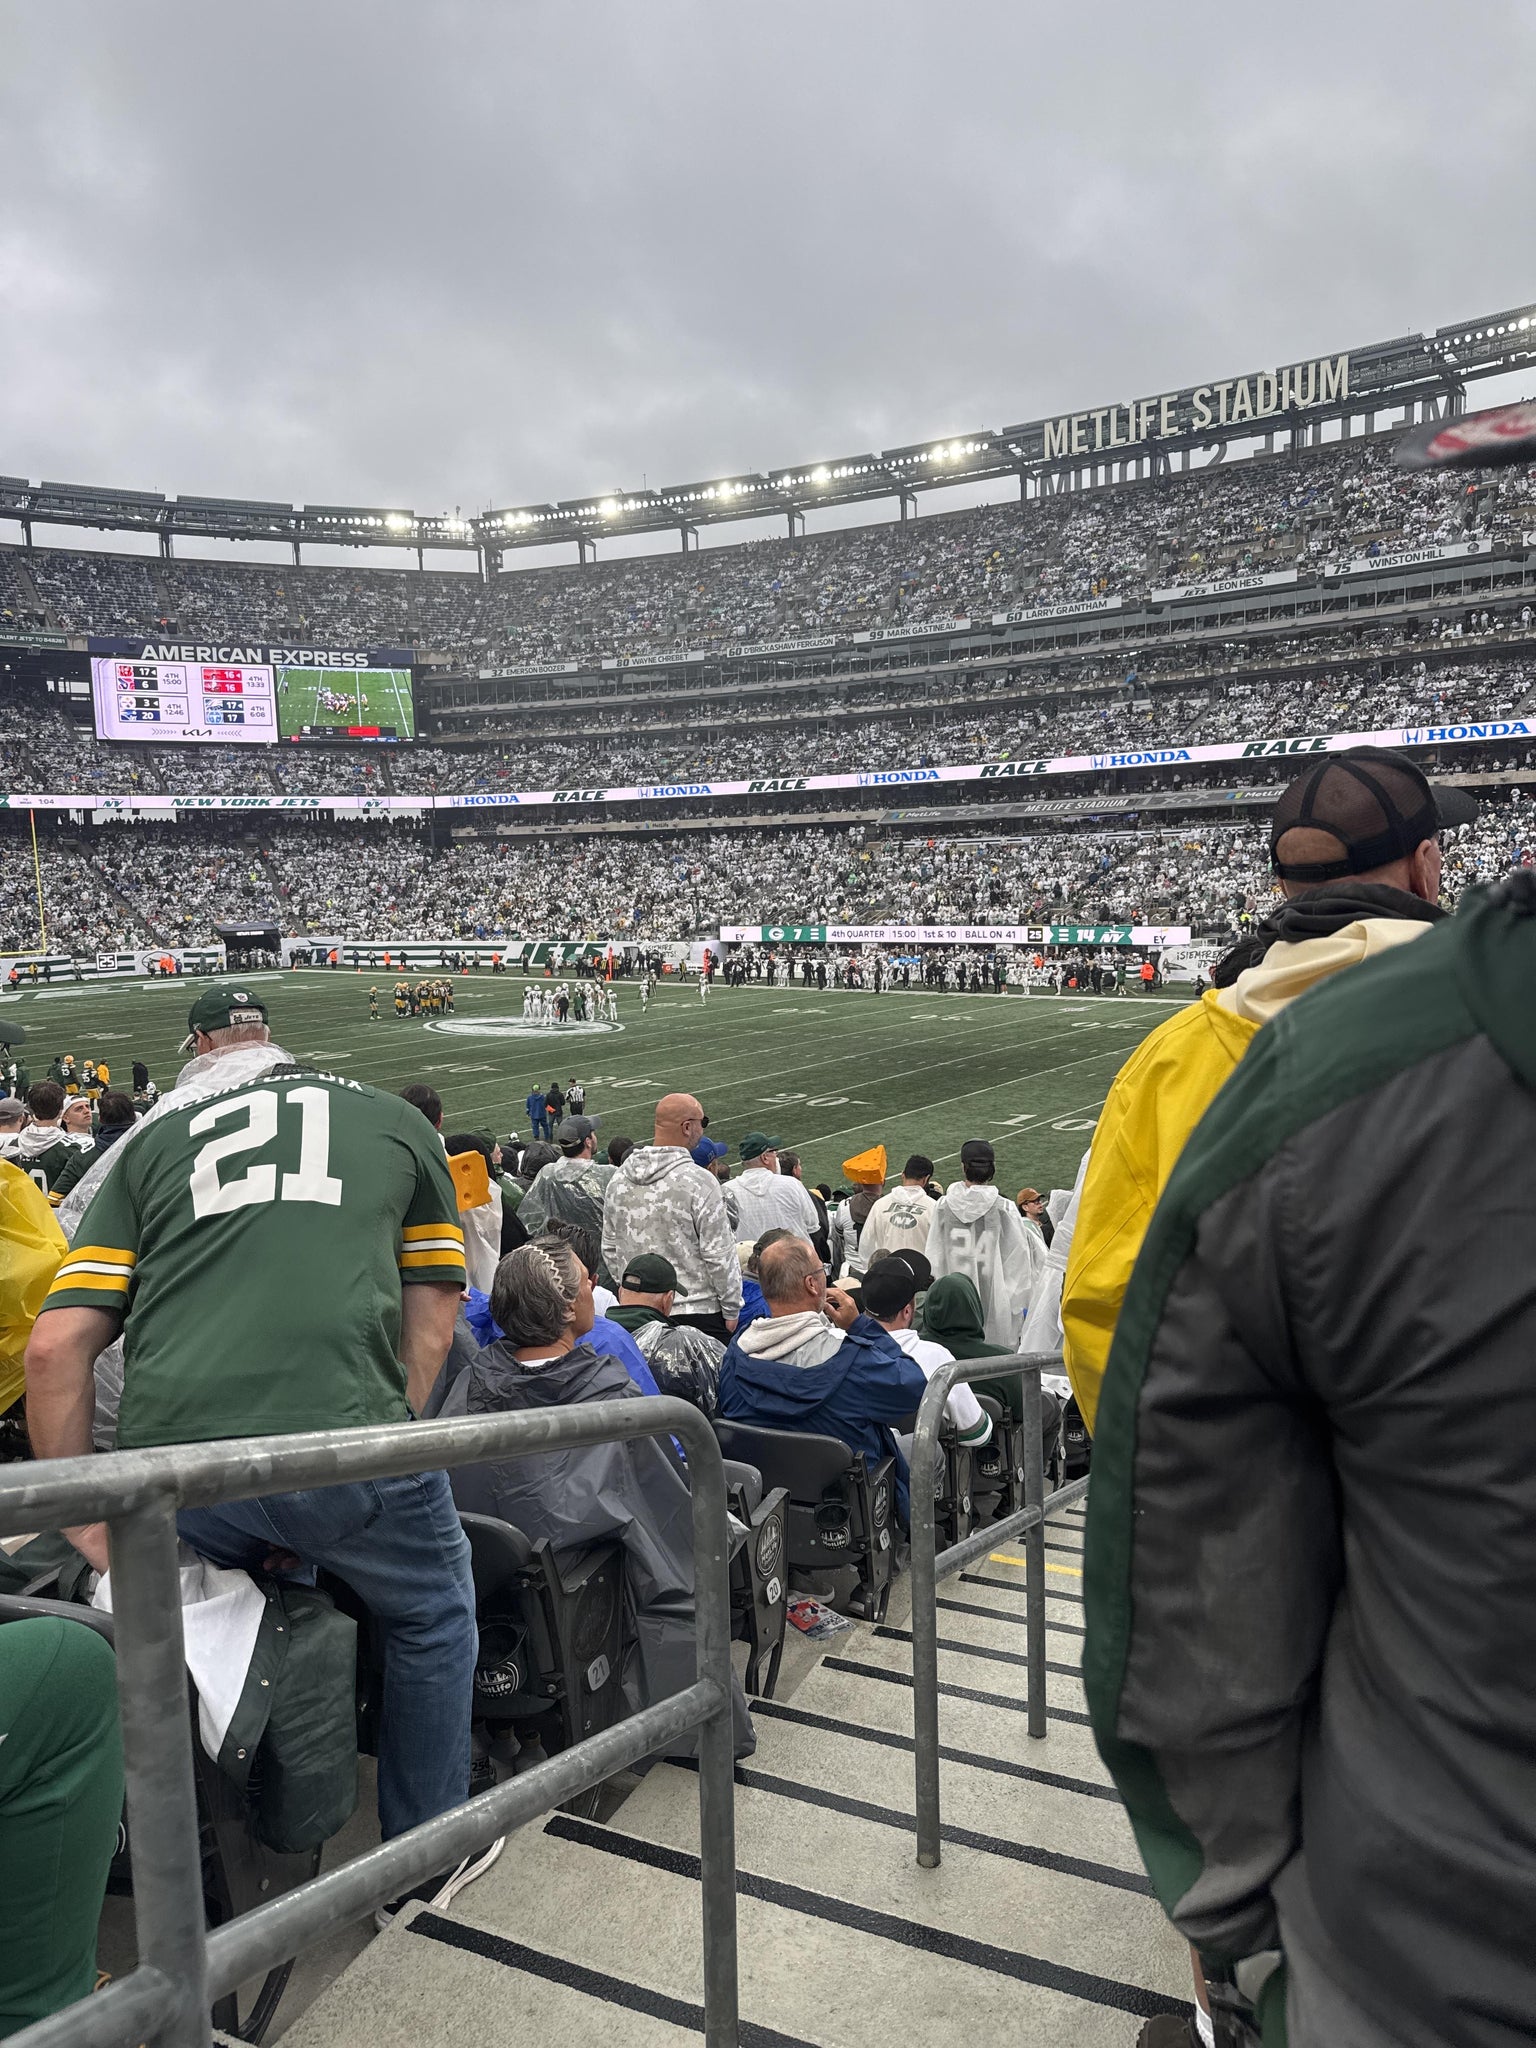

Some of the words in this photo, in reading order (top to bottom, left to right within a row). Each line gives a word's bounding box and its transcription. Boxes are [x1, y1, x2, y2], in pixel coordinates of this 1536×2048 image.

[1043, 394, 1181, 459] METLIFE
[1192, 355, 1350, 429] STADIUM
[1333, 562, 1351, 576] 75
[1368, 553, 1421, 570] WINSTON
[1422, 549, 1446, 562] HILL
[1180, 586, 1209, 598] JETS
[1213, 580, 1237, 592] LEON
[1238, 576, 1264, 589] HESS
[1005, 611, 1022, 622] 60
[1026, 607, 1054, 619] LARRY
[1056, 600, 1108, 615] GRANTHAM
[869, 631, 884, 640] 99
[887, 627, 911, 638] MARK
[912, 622, 957, 635] GASTINEAU
[729, 648, 742, 656] 60
[797, 638, 834, 649] FERGUSON
[140, 645, 263, 663] AMERICAN
[269, 649, 369, 667] EXPRESS
[616, 658, 629, 667] 80
[631, 655, 657, 666] WAYNE
[657, 653, 689, 663] CHREBET
[139, 667, 150, 676] 17
[224, 671, 235, 679] 16
[491, 669, 504, 677] 32
[506, 667, 538, 676] EMERSON
[539, 664, 566, 673] BOOZER
[141, 680, 149, 689] 6
[225, 684, 235, 692] 16
[143, 699, 150, 707] 3
[226, 701, 237, 710] 17
[141, 712, 154, 720] 20
[227, 714, 237, 722] 17
[1427, 722, 1532, 741] HONDA
[1241, 736, 1334, 757] RACE
[1110, 750, 1192, 766] HONDA
[979, 760, 1051, 778] RACE
[873, 769, 942, 784] HONDA
[652, 785, 712, 798] HONDA
[748, 778, 810, 793] RACE
[464, 795, 520, 806] HONDA
[552, 790, 608, 802] RACE
[1245, 789, 1285, 799] MetLif
[171, 798, 216, 807] NEW
[221, 798, 273, 806] YORK
[276, 798, 322, 806] JETS
[1025, 800, 1073, 813] METLIFE
[1075, 798, 1129, 810] STADIUM
[905, 810, 942, 819] MetLife
[735, 933, 745, 941] EY
[793, 928, 803, 940] 7
[831, 930, 846, 938] 4th
[847, 930, 885, 938] QUARTER
[892, 930, 916, 938] 15:00
[923, 930, 935, 938] 1st
[945, 930, 956, 938] 10
[965, 930, 985, 939] BALL
[986, 930, 1002, 938] ON
[1005, 930, 1016, 938] 41
[1028, 930, 1042, 940] 25
[1077, 929, 1096, 942] 14
[1153, 935, 1166, 944] EY
[506, 943, 608, 965] JETS
[99, 955, 115, 967] 25
[757, 1092, 851, 1107] 20
[988, 1113, 1099, 1131] 10
[189, 1085, 343, 1221] 21
[883, 1201, 928, 1216] JETS
[892, 1214, 915, 1227] NY
[769, 1582, 779, 1601] 20
[592, 1659, 606, 1685] 21
